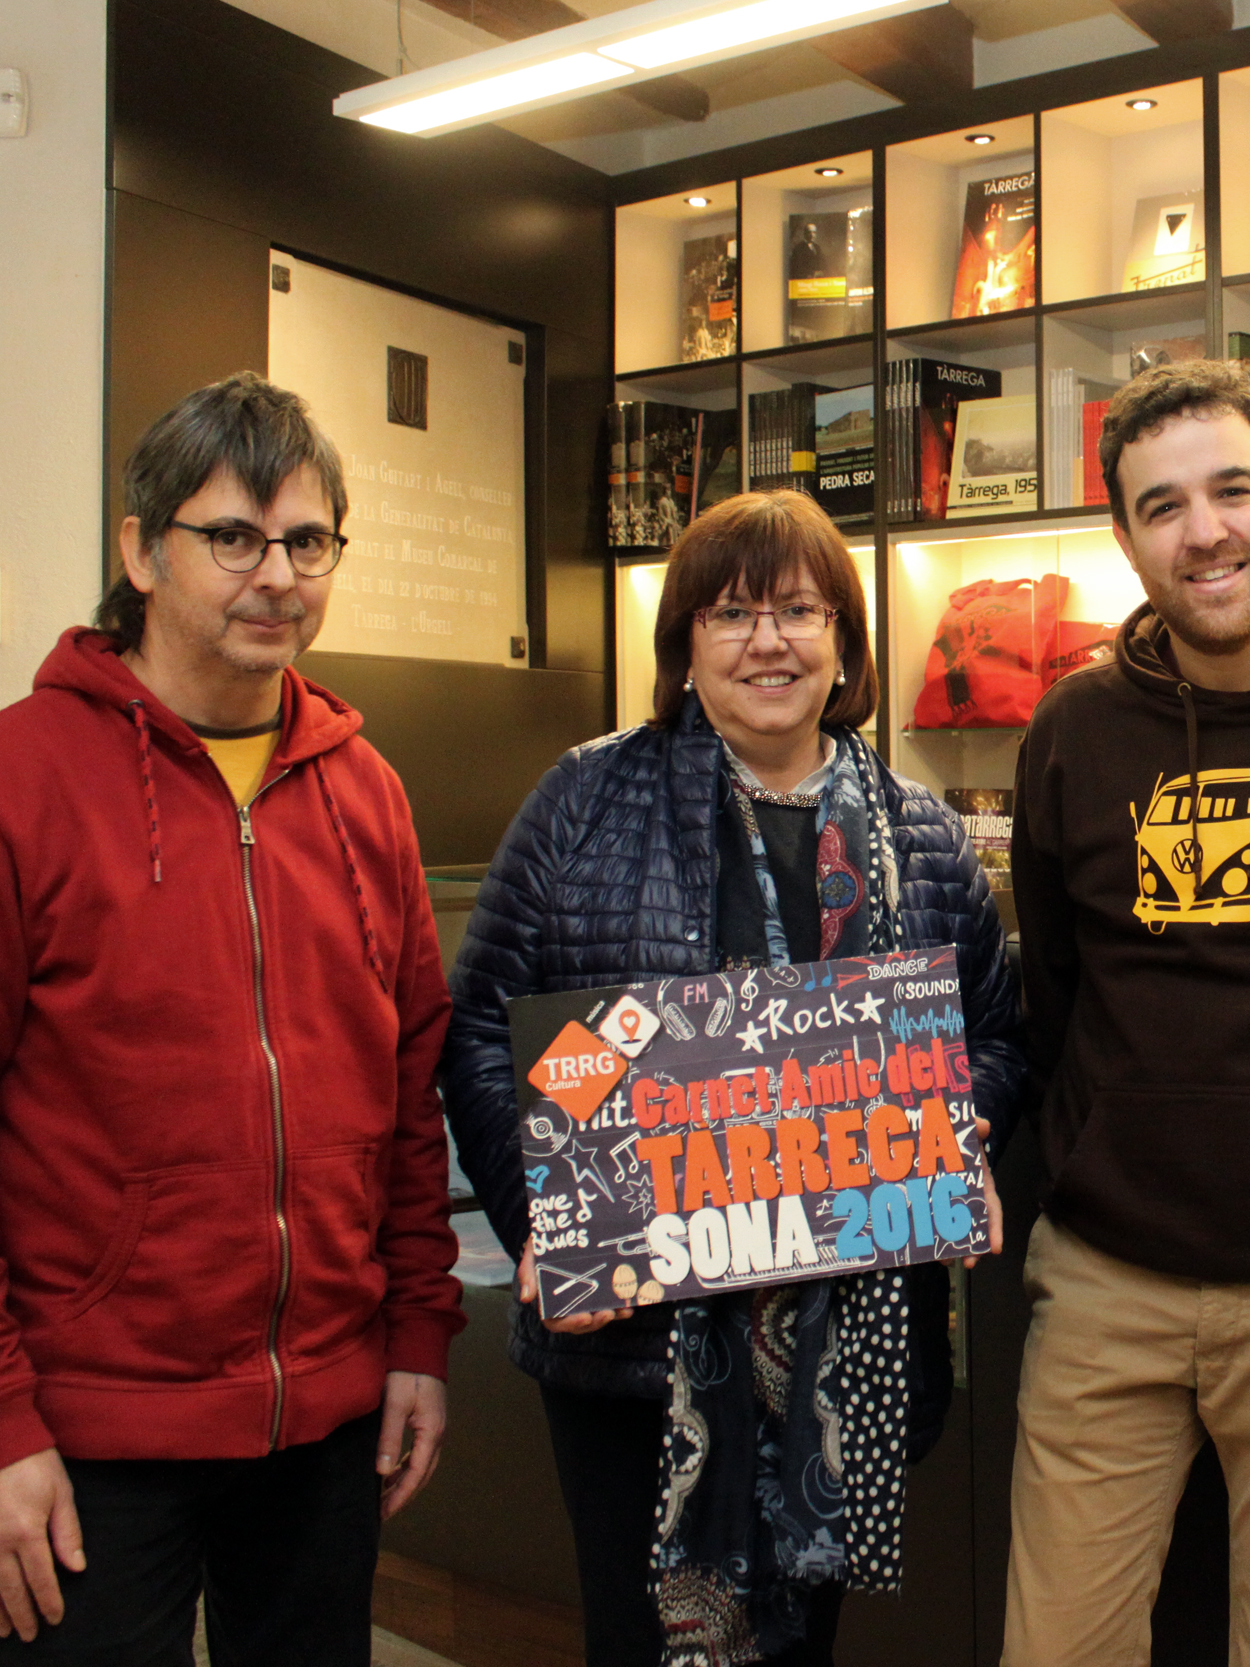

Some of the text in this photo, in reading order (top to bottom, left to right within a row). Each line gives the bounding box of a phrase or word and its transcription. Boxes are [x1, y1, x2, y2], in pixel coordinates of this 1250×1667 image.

[936, 364, 986, 387] TÀRREGA
[820, 470, 875, 490] PEDRA SECA
[958, 484, 1010, 501] Tàrrega,
[868, 957, 929, 980] DANCE
[683, 982, 709, 1006] FM
[758, 992, 856, 1040] Rock
[543, 1051, 616, 1081] TRRG
[545, 1078, 582, 1091] Cultura
[632, 1068, 772, 1129] Carnet
[782, 1049, 881, 1110] Amic
[886, 1038, 946, 1095] del
[636, 1097, 965, 1216] TÀRREGA
[529, 1193, 573, 1217] ove
[532, 1211, 572, 1232] the
[648, 1174, 972, 1286] SONA 2016
